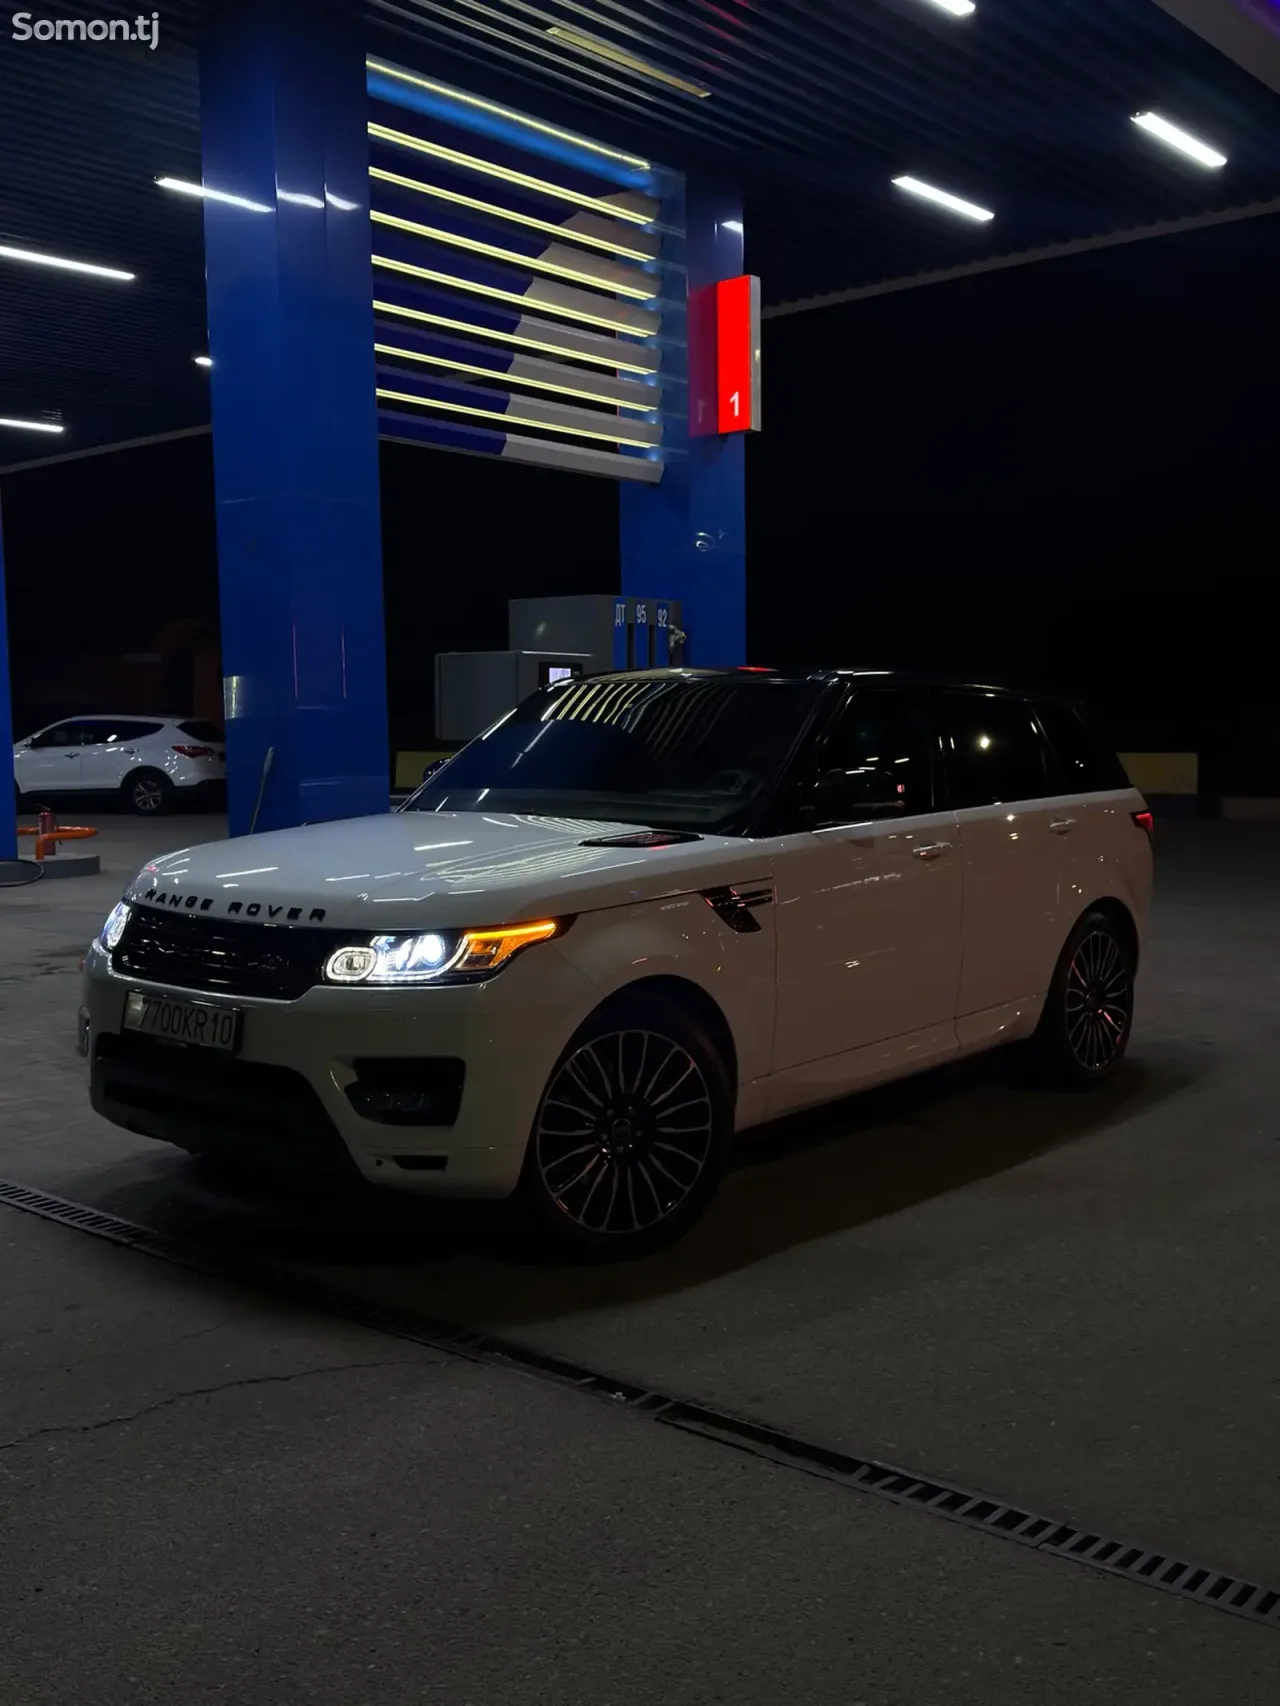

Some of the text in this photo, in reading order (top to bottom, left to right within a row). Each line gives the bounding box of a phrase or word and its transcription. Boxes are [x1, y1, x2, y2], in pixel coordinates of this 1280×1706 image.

[728, 390, 741, 417] 1
[614, 603, 668, 628] ДТ 95 92
[144, 888, 326, 922] RANGE ROVER
